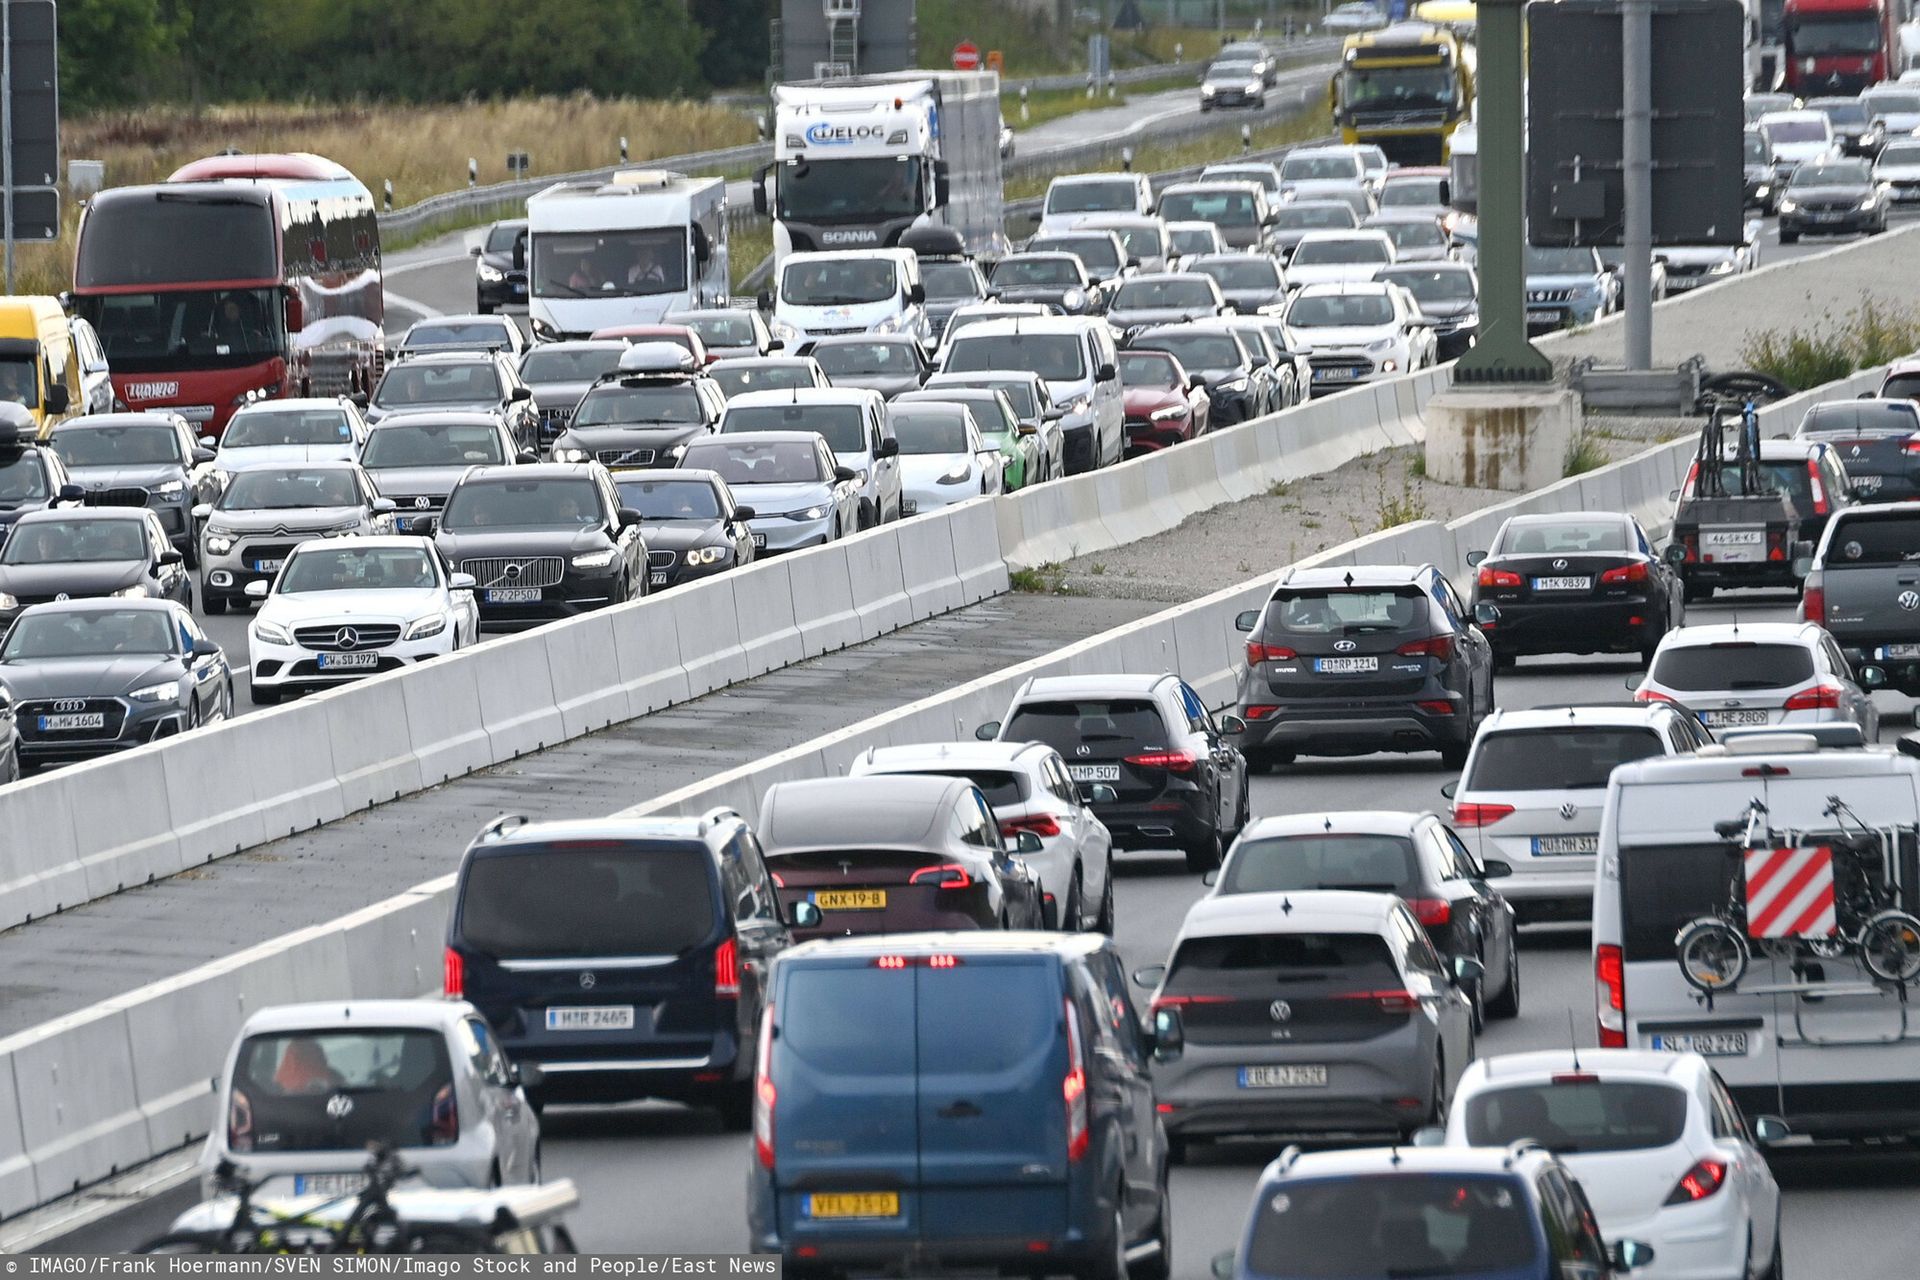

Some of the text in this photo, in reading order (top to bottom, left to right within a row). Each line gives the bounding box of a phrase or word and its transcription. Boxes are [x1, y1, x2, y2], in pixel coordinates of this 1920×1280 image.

[822, 231, 877, 244] SCANIA
[1562, 579, 1586, 587] 9839
[491, 589, 539, 600] PZ 2P507
[324, 653, 377, 666] CW SD 1971
[1321, 659, 1377, 670] ED RP 1214
[75, 715, 101, 725] 1604
[1721, 712, 1735, 722] HE
[1739, 711, 1766, 722] 2809
[1079, 767, 1118, 778] MP 507
